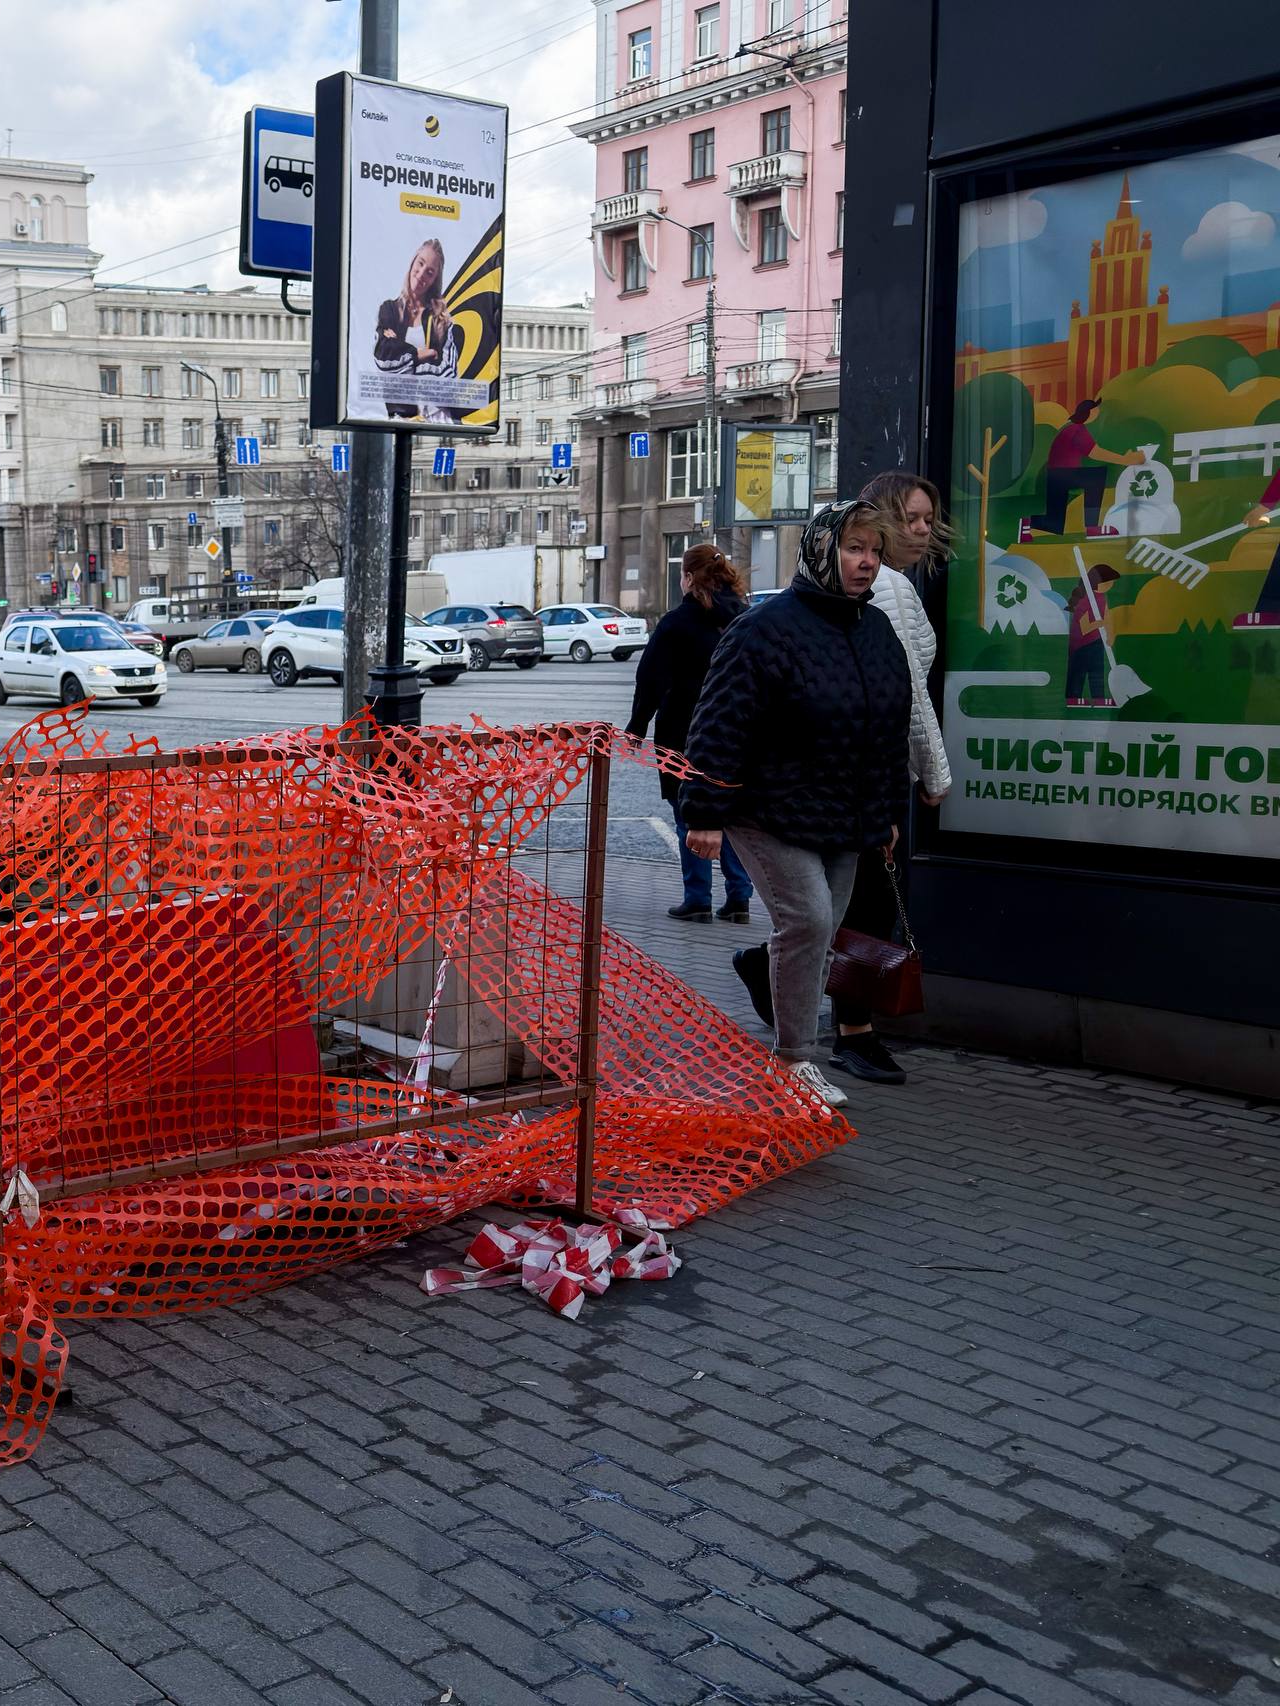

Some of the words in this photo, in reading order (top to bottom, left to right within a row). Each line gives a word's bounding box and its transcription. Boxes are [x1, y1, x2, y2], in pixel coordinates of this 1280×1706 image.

[361, 109, 389, 122] билайн
[481, 130, 497, 144] 12+
[395, 152, 413, 161] если
[414, 155, 432, 166] связь
[360, 161, 434, 189] вернем
[437, 173, 496, 199] деньги
[405, 200, 426, 210] одной
[427, 202, 455, 214] кнопкой
[966, 734, 1181, 779] ЧИСТЫЙ
[965, 780, 1090, 806] НАВЕДЕМ
[1098, 787, 1241, 815] ПОРЯДОК
